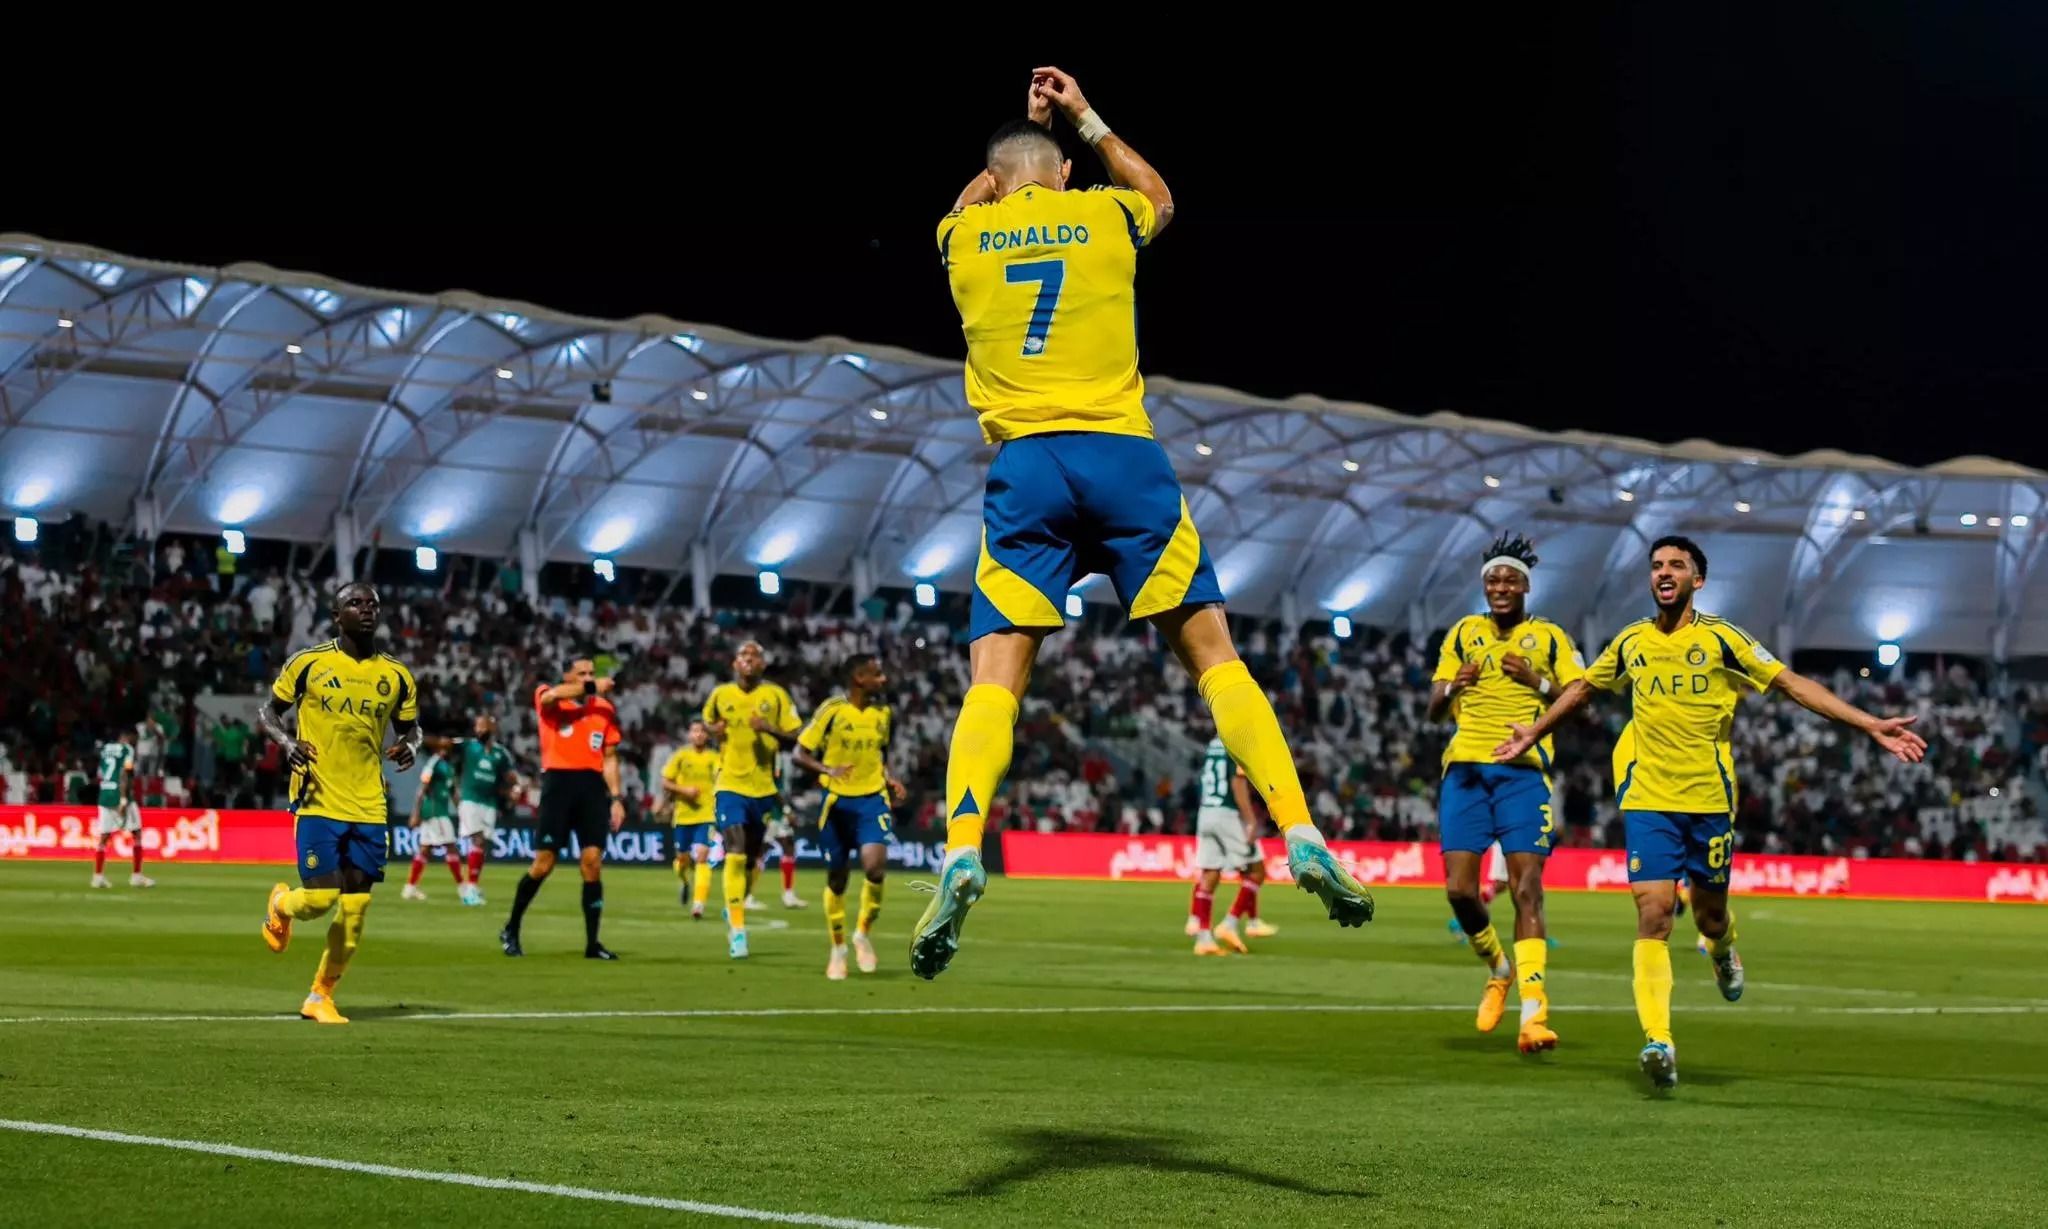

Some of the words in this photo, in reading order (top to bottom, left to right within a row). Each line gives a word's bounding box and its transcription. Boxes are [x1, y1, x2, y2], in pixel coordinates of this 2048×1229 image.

[979, 224, 1089, 253] RONALDO
[1004, 258, 1066, 357] 7
[1539, 804, 1553, 833] 3
